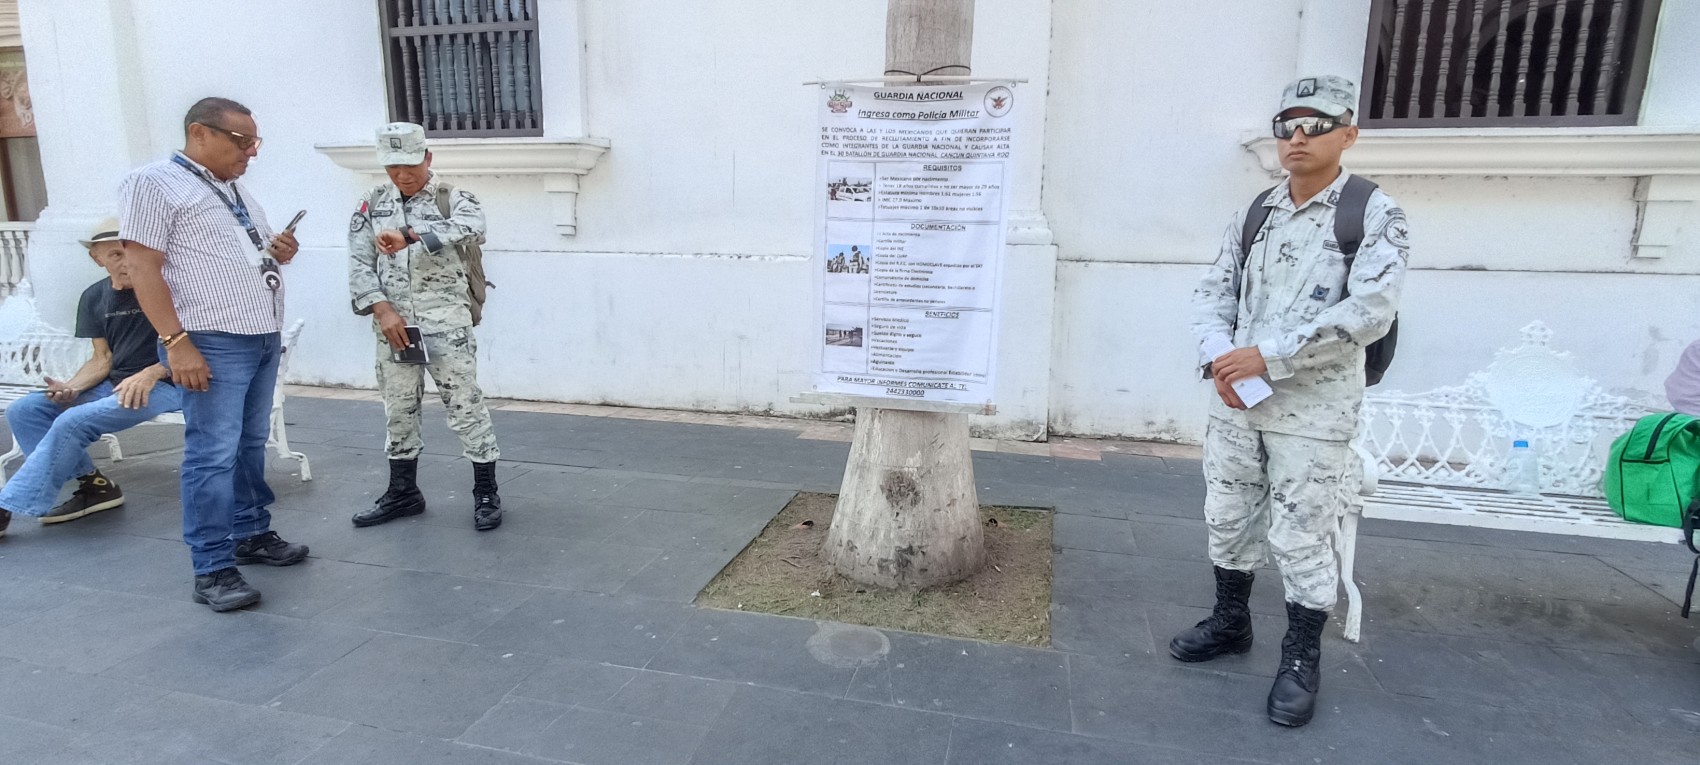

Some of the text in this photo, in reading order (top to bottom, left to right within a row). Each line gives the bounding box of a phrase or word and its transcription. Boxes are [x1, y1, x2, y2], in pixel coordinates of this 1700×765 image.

[874, 91, 963, 100] GUARDIA NACIONAL
[858, 109, 891, 119] Ingresa
[893, 111, 915, 119] como
[949, 108, 980, 118] Militar
[925, 311, 959, 319] BENEFICIOS
[876, 379, 907, 387] INFORMES
[908, 381, 949, 389] COMUNICATE
